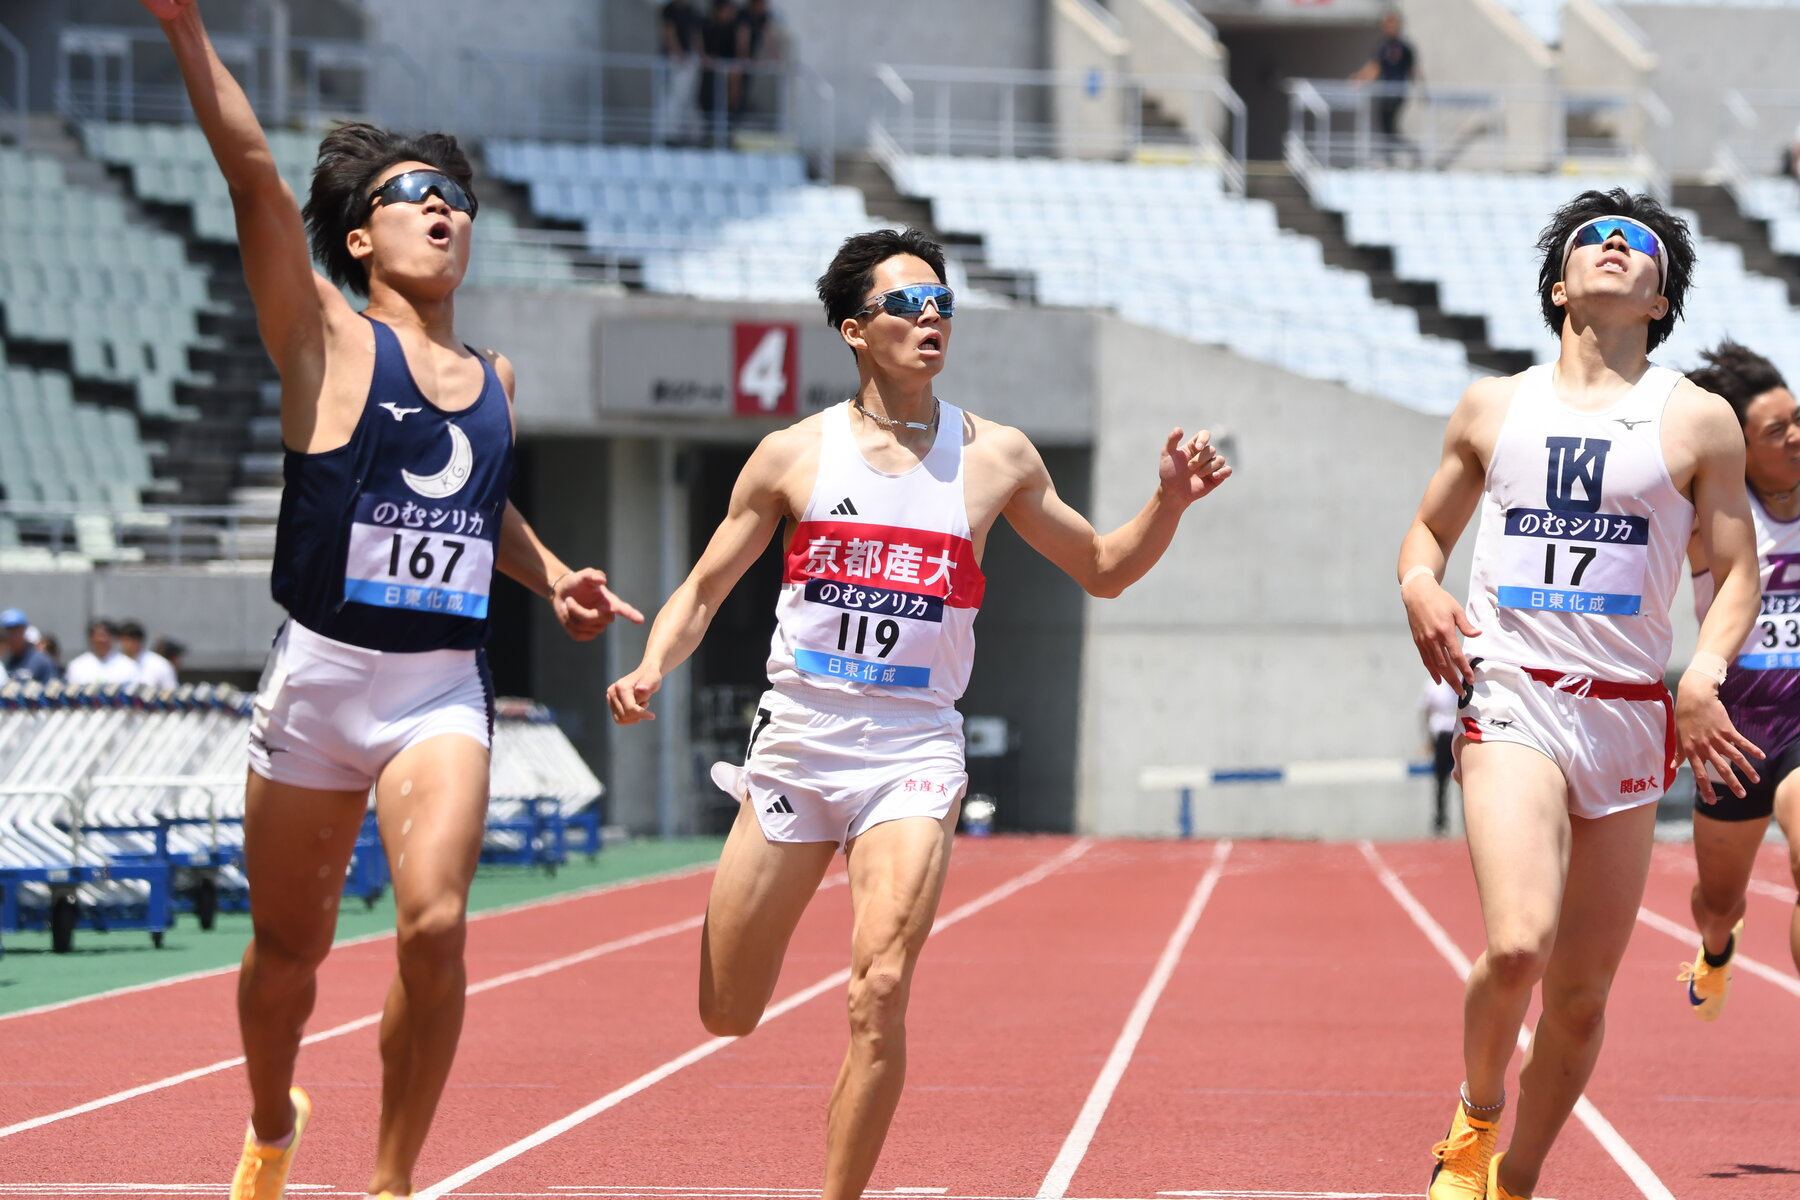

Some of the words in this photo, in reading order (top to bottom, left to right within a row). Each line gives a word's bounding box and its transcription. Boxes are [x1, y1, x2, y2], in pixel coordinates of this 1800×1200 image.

[738, 327, 787, 411] 4
[373, 501, 484, 536] のむシリカ
[1518, 512, 1633, 541] のむシリカ
[388, 533, 465, 583] 167
[804, 535, 958, 587] 京都産大
[1543, 543, 1597, 586] 17
[384, 586, 464, 612] 日東化成
[819, 583, 929, 617] のむシリカ
[1531, 591, 1606, 613] 日東化成
[837, 612, 900, 659] 119
[1761, 620, 1800, 648] 33
[828, 658, 896, 683] 日東化成
[902, 778, 949, 798] 京産大
[1620, 775, 1658, 794] 関西大
